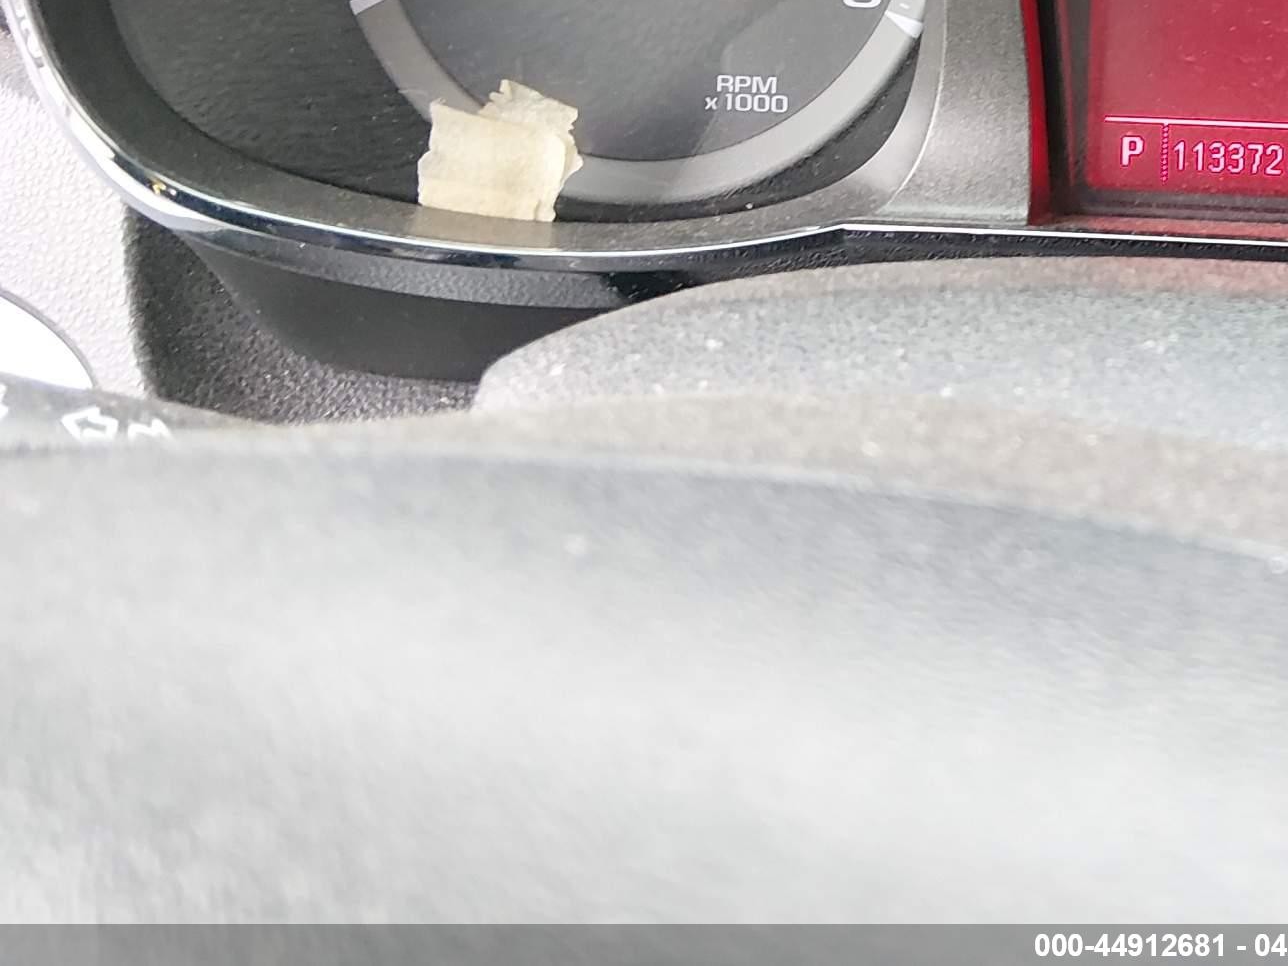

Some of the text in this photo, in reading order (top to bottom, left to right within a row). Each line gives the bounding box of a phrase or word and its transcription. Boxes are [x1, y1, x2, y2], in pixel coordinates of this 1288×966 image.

[716, 75, 777, 94] RPM
[1121, 135, 1144, 166] P
[1174, 141, 1283, 175] 113372
